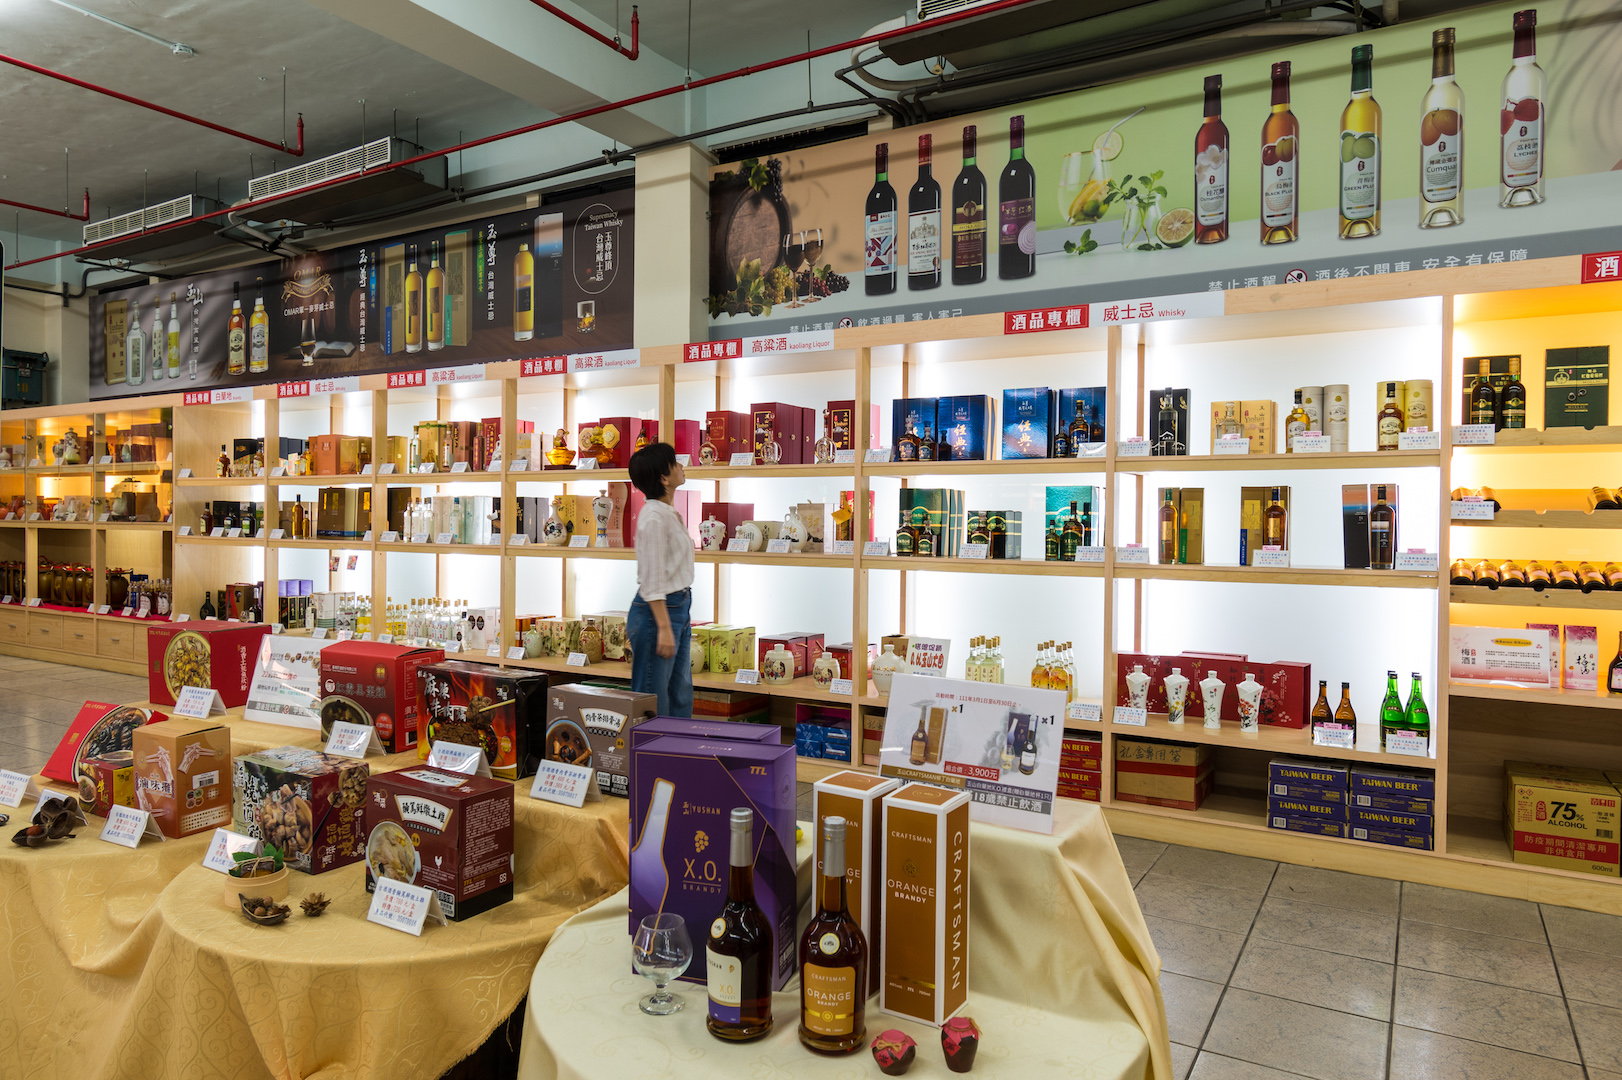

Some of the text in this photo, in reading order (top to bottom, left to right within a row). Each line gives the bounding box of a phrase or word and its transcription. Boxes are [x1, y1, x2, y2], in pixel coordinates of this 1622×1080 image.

[589, 211, 618, 221] Supremacy
[584, 218, 624, 232] Taiwan Whisky
[294, 266, 322, 281] OMAR
[1594, 256, 1620, 278] 酒
[1102, 302, 1186, 322] 威士忌 Whisky
[1011, 308, 1082, 330] 酒品專櫃
[688, 341, 739, 360] 酒品專櫃
[751, 337, 830, 352] 高粱酒 kaoliang Liquor
[524, 359, 564, 374] 酒品專櫃
[574, 356, 604, 370] 高粱酒
[623, 358, 638, 366] Liquor
[390, 372, 423, 386] 酒品專櫃
[432, 370, 456, 382] 高粱酒
[279, 383, 308, 396] 酒品專櫃
[314, 382, 334, 392] 威士忌
[186, 390, 210, 404] 酒品專櫃
[216, 392, 232, 401] 白蘭地
[1072, 743, 1090, 752] BEER
[750, 766, 767, 776] TTL
[1072, 773, 1090, 782] BEER
[1280, 769, 1333, 782] TAIWAN BEER
[1362, 778, 1418, 791] TAIWAN BEER
[692, 805, 720, 816] YUSHAN
[1279, 801, 1332, 814] TAIWAN BEER
[1360, 812, 1416, 825] TAIWAN BEER
[1548, 820, 1588, 830] ALCOHOL
[891, 831, 932, 844] CRAFTSMAN
[1524, 835, 1606, 853] 防疫期間清潔專用
[1545, 847, 1585, 859] 非供食用
[684, 858, 722, 882] X.O.
[1592, 864, 1612, 872] 600ml
[683, 884, 722, 894] BRANDY
[888, 879, 935, 897] ORANGE
[894, 892, 926, 904] BRANDY
[952, 830, 962, 990] CRAFTSMAN
[812, 973, 846, 982] CRAFTSMAN
[720, 984, 736, 995] X.O.
[807, 988, 851, 1001] ORANGE
